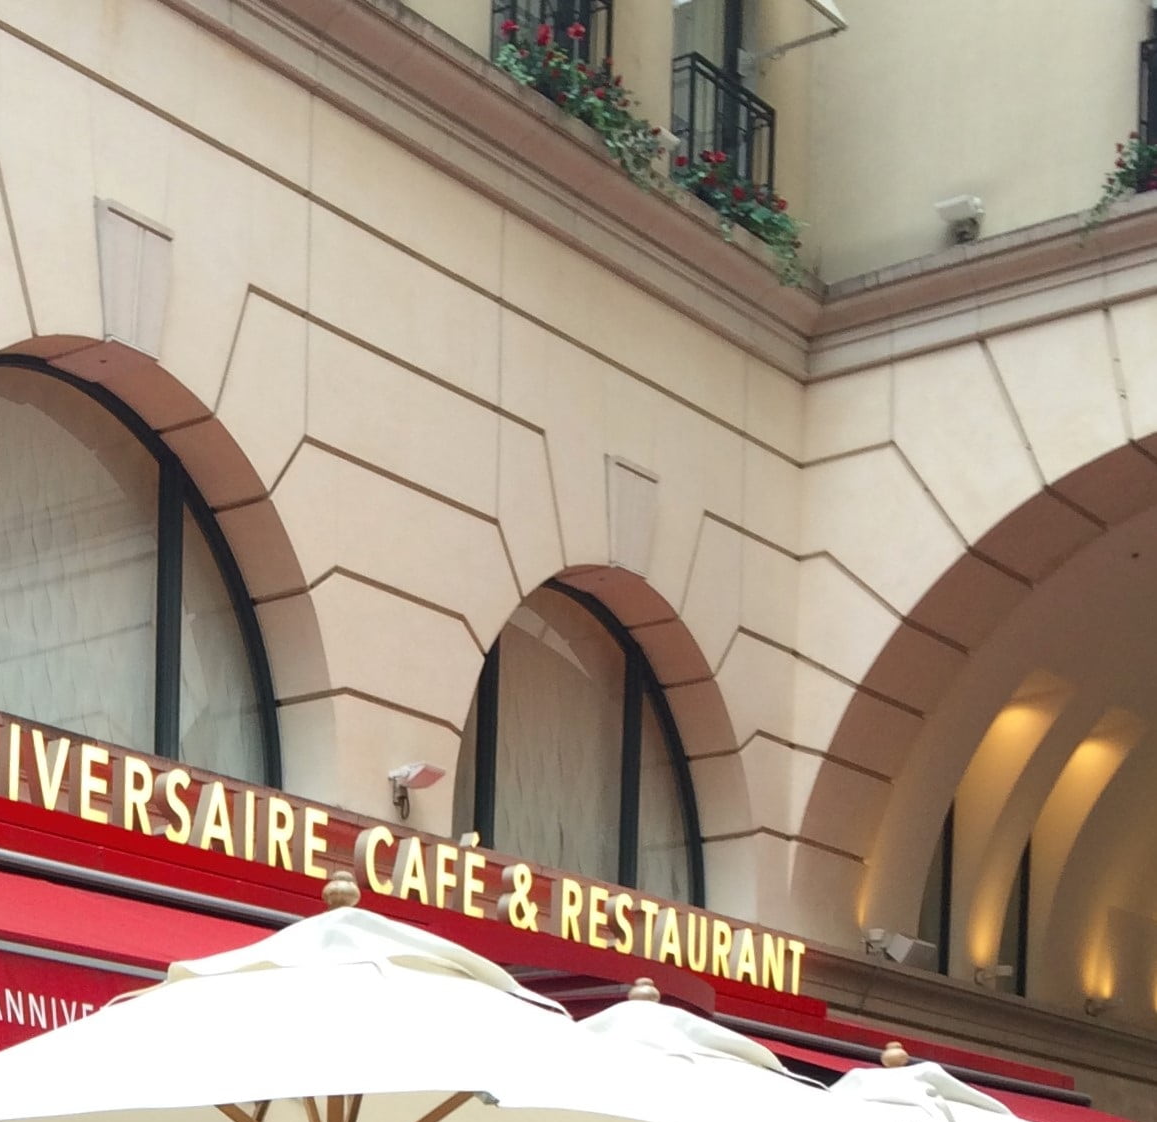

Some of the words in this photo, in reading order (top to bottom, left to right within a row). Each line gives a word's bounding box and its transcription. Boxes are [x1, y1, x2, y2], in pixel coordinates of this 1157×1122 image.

[364, 825, 486, 919] CAFÉ
[507, 863, 539, 933] &
[561, 878, 806, 996] RESTAURANT
